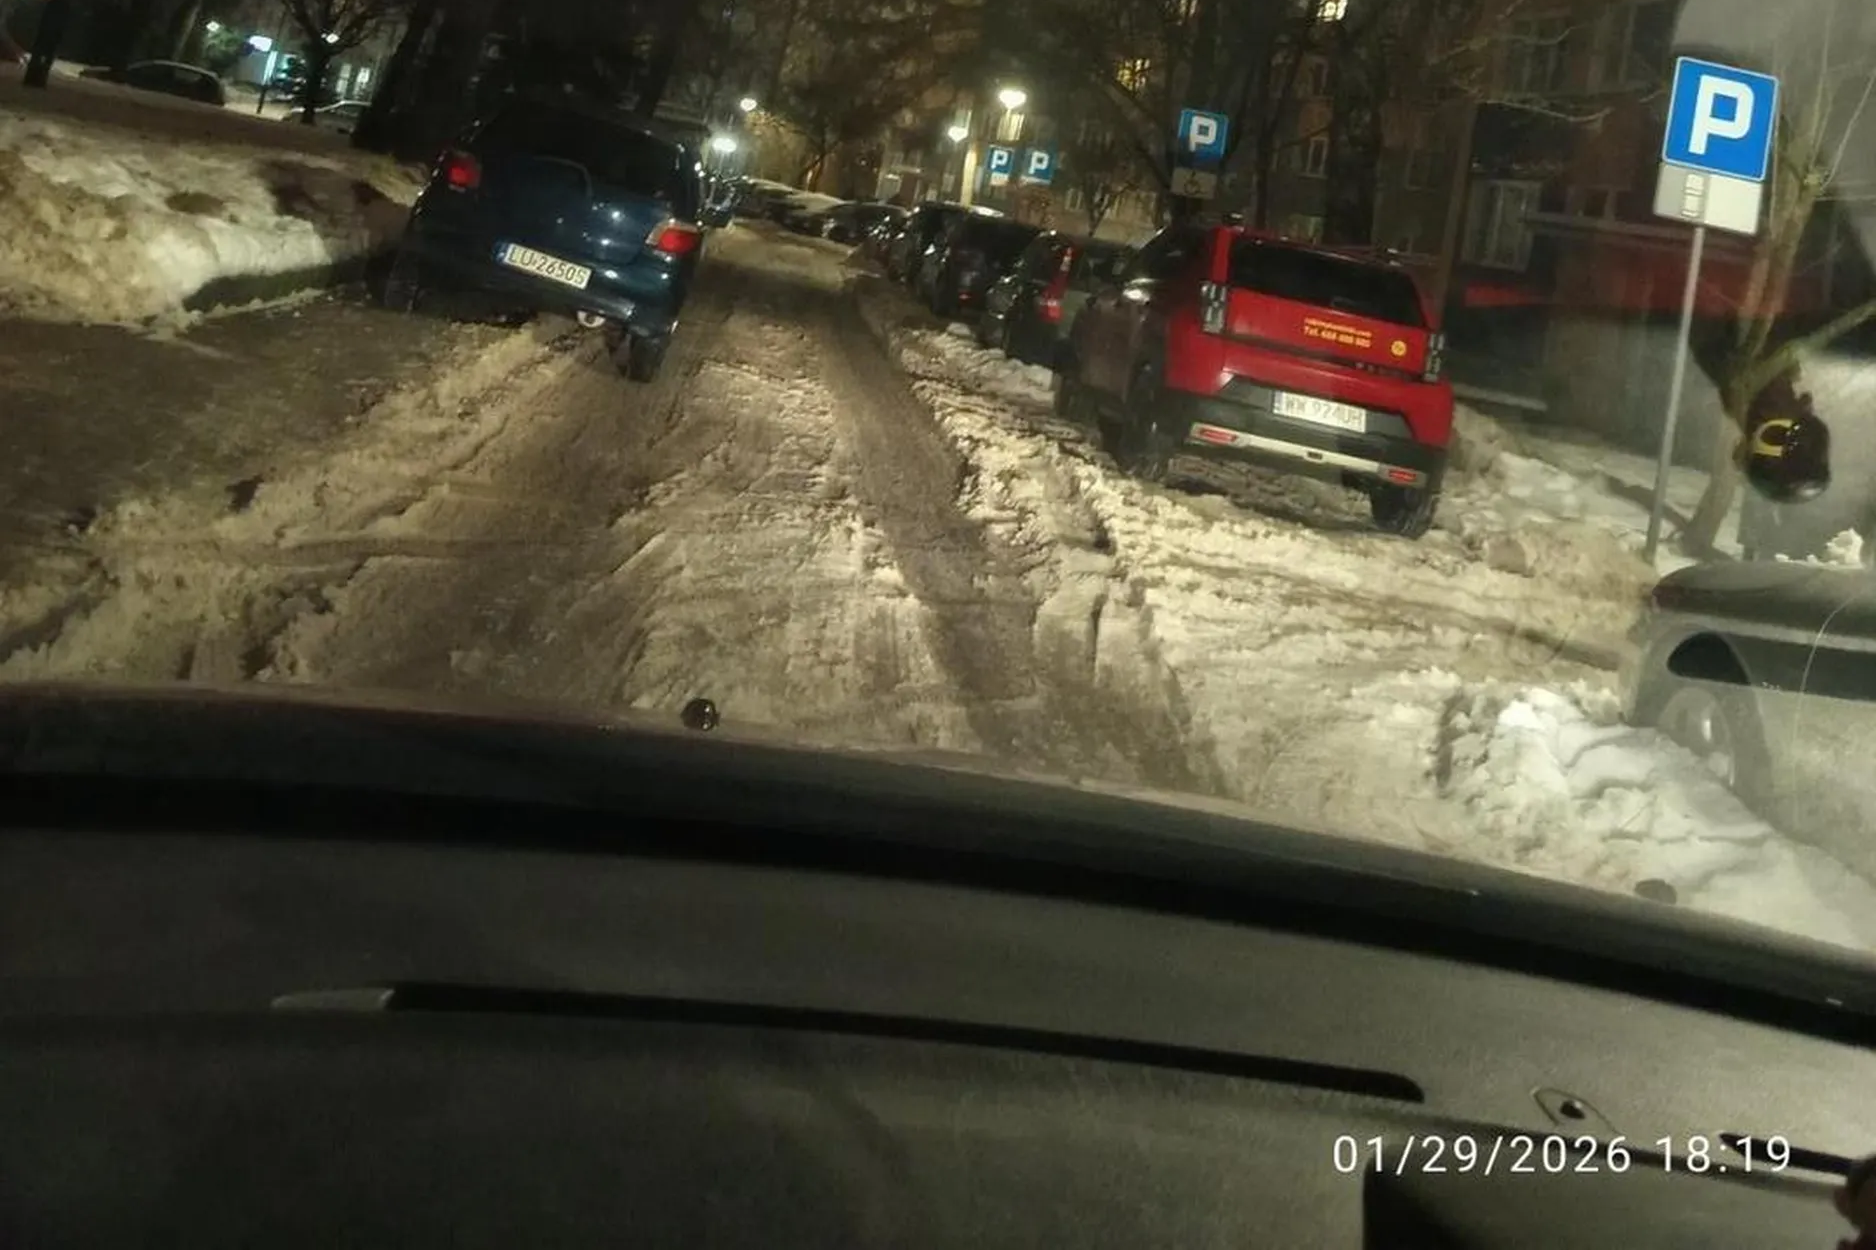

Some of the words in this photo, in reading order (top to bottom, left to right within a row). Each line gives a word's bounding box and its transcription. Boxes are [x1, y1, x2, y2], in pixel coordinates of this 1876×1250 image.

[1688, 74, 1755, 156] P
[1188, 114, 1218, 153] P
[991, 149, 1008, 169] P
[1028, 151, 1050, 174] P
